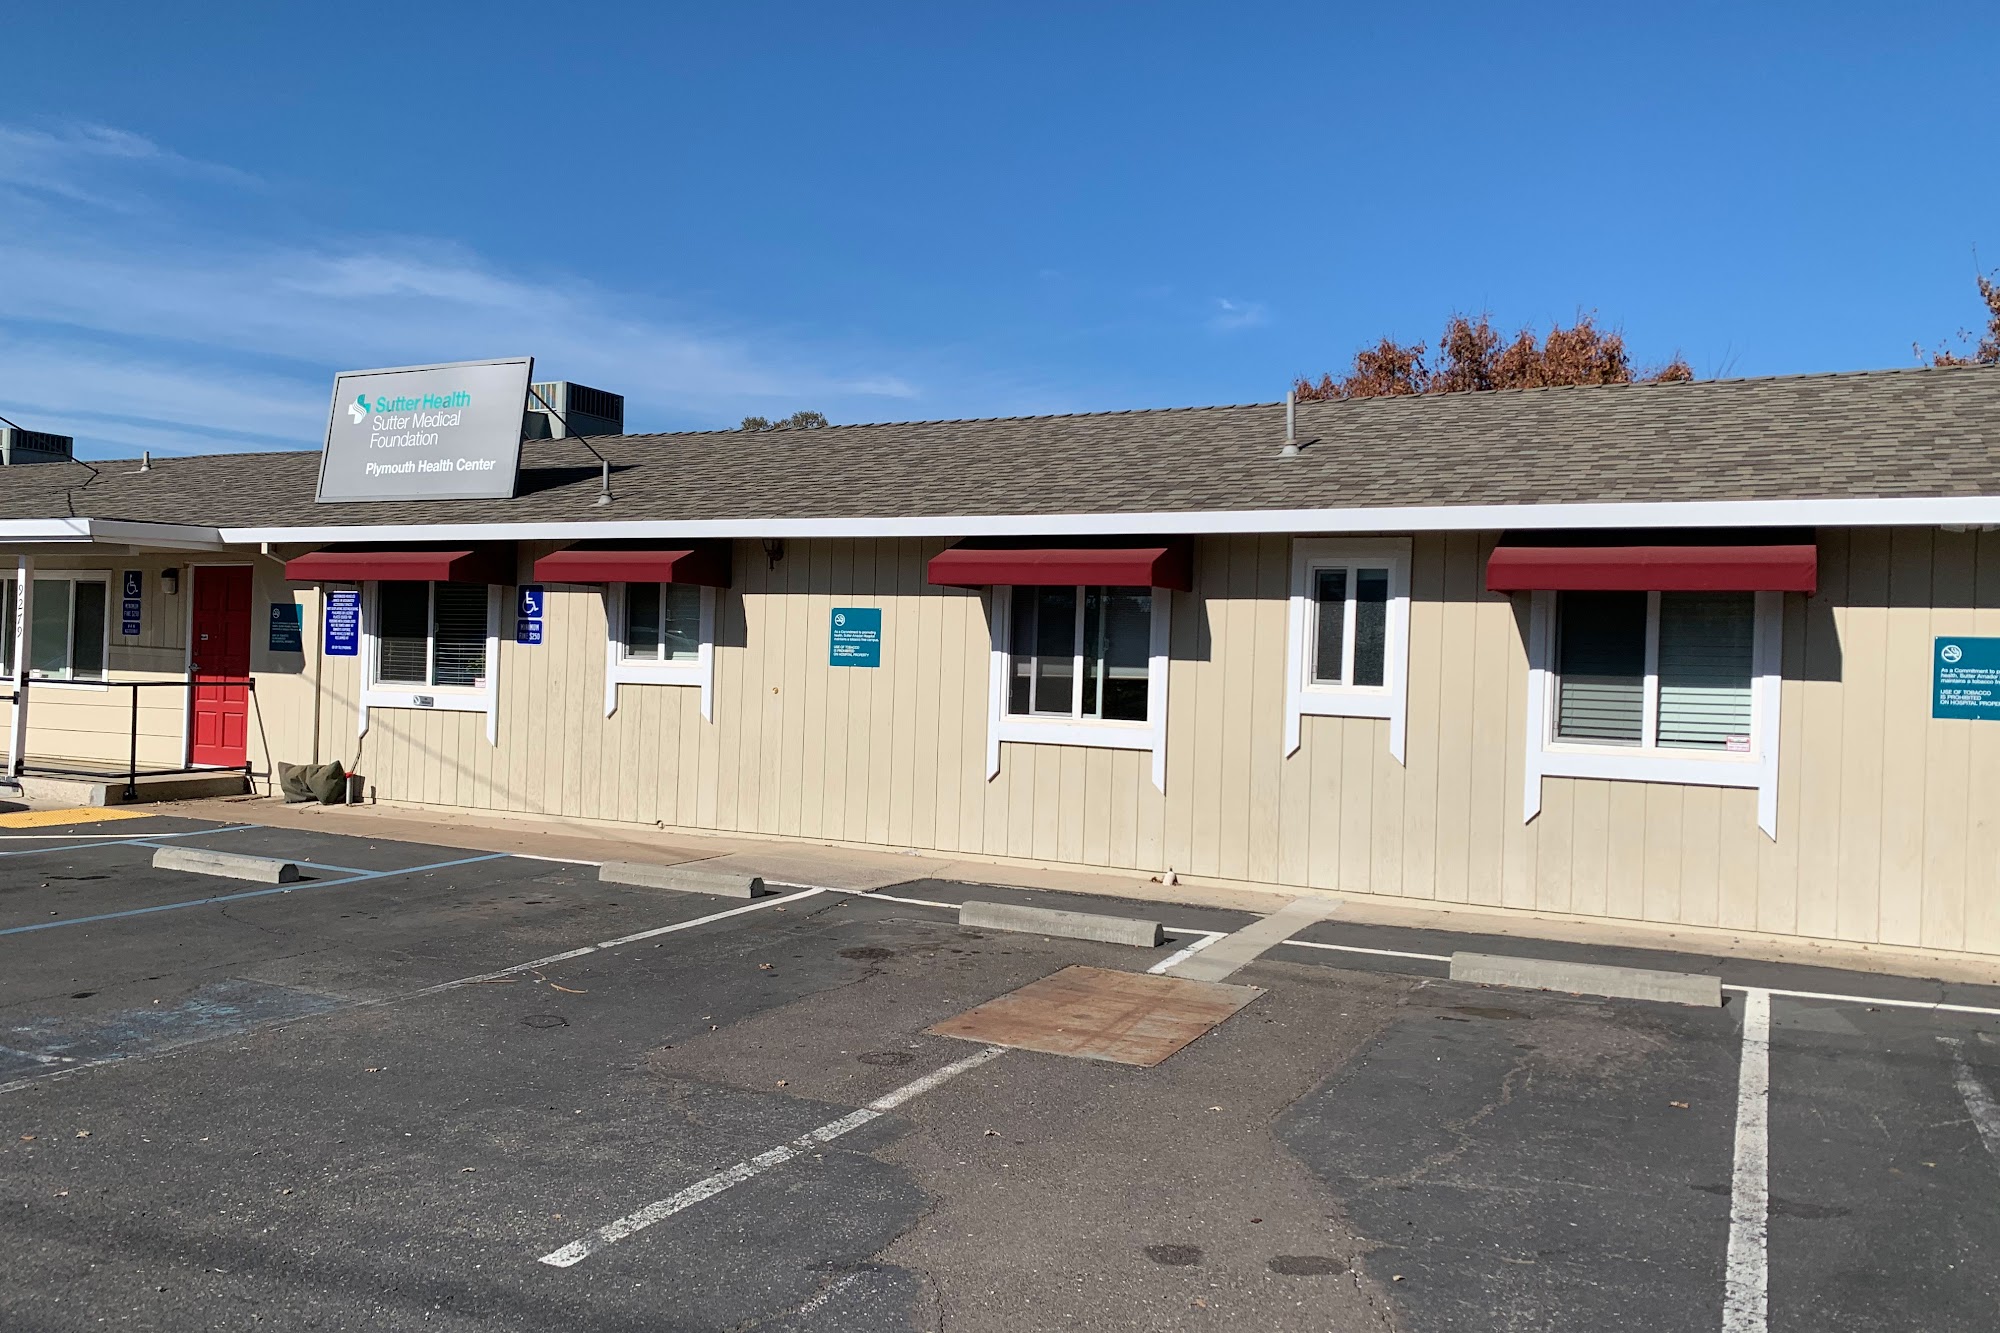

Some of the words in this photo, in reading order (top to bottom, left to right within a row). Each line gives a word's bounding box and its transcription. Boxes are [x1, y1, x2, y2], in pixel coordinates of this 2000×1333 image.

[376, 396, 420, 413] Sutter
[423, 391, 470, 410] Health
[372, 415, 410, 431] Sutter
[412, 410, 461, 428] Medical
[369, 430, 439, 448] Foundation
[365, 461, 416, 477] Plymouth
[417, 459, 453, 473] Health
[456, 457, 496, 471] Center
[529, 632, 540, 640] $250
